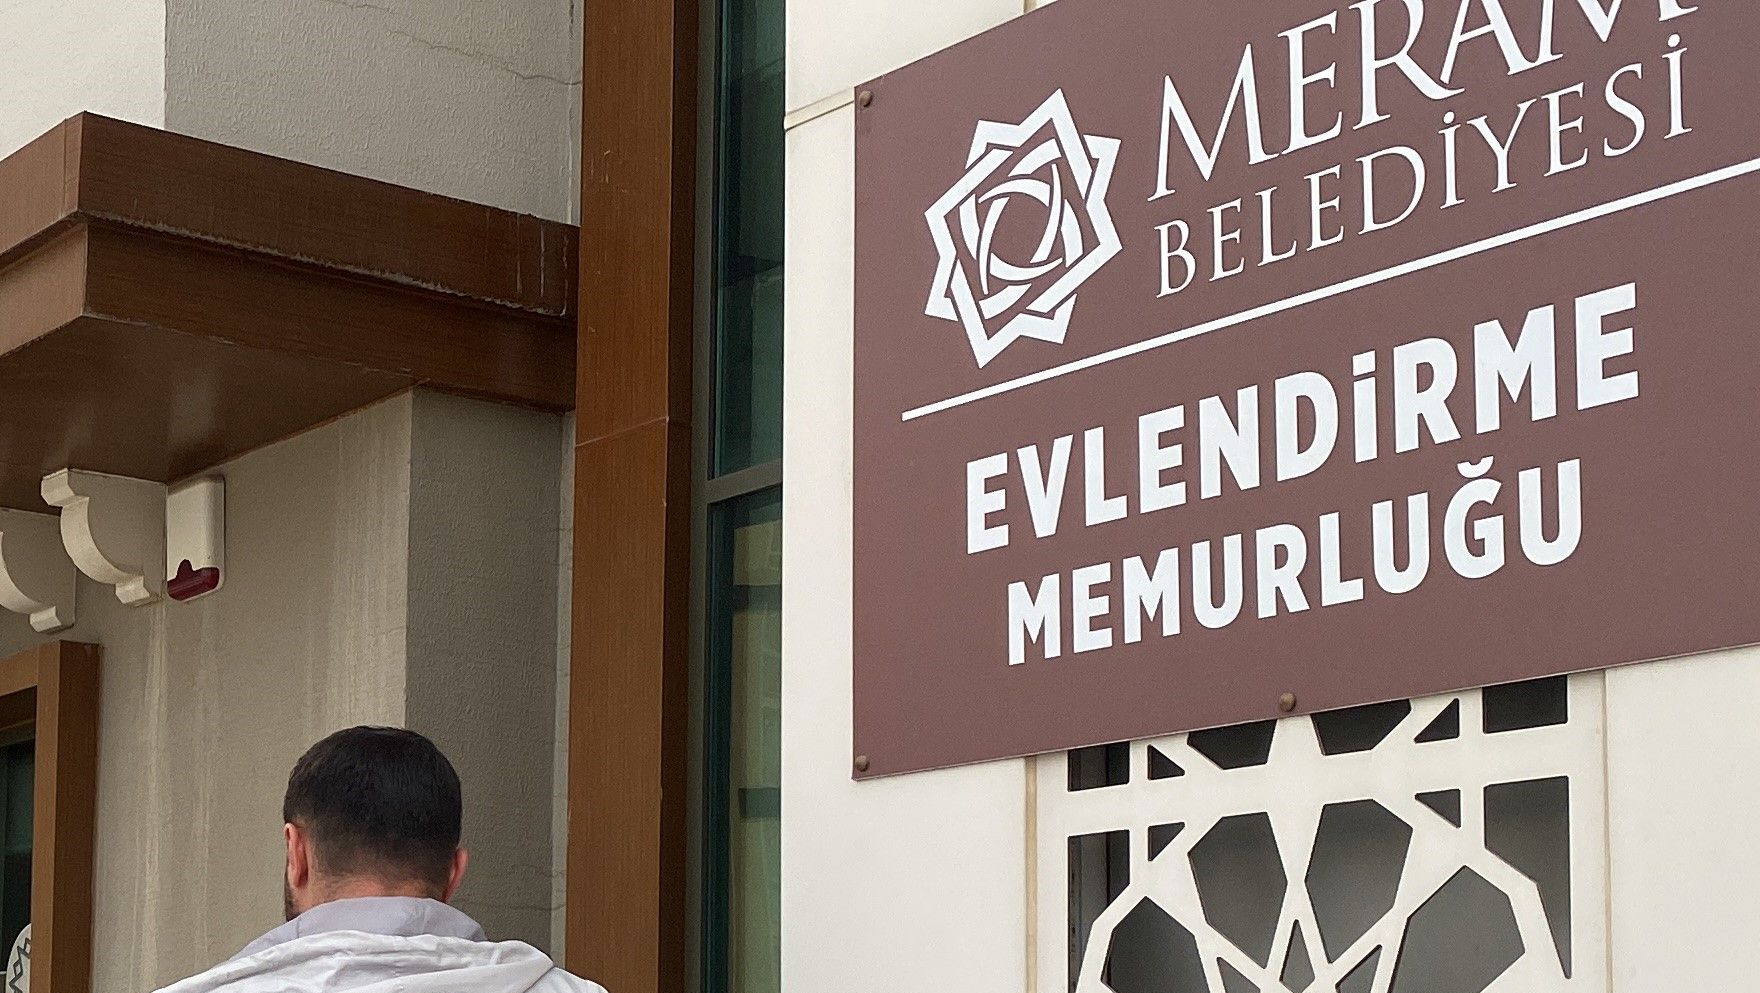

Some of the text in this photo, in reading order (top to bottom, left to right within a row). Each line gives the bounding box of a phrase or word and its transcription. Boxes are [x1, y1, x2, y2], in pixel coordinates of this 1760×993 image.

[1154, 34, 1692, 298] BELEDİYESİ
[967, 282, 1639, 555] EVLENDİRME
[1008, 456, 1582, 665] MEMURLUĞU
